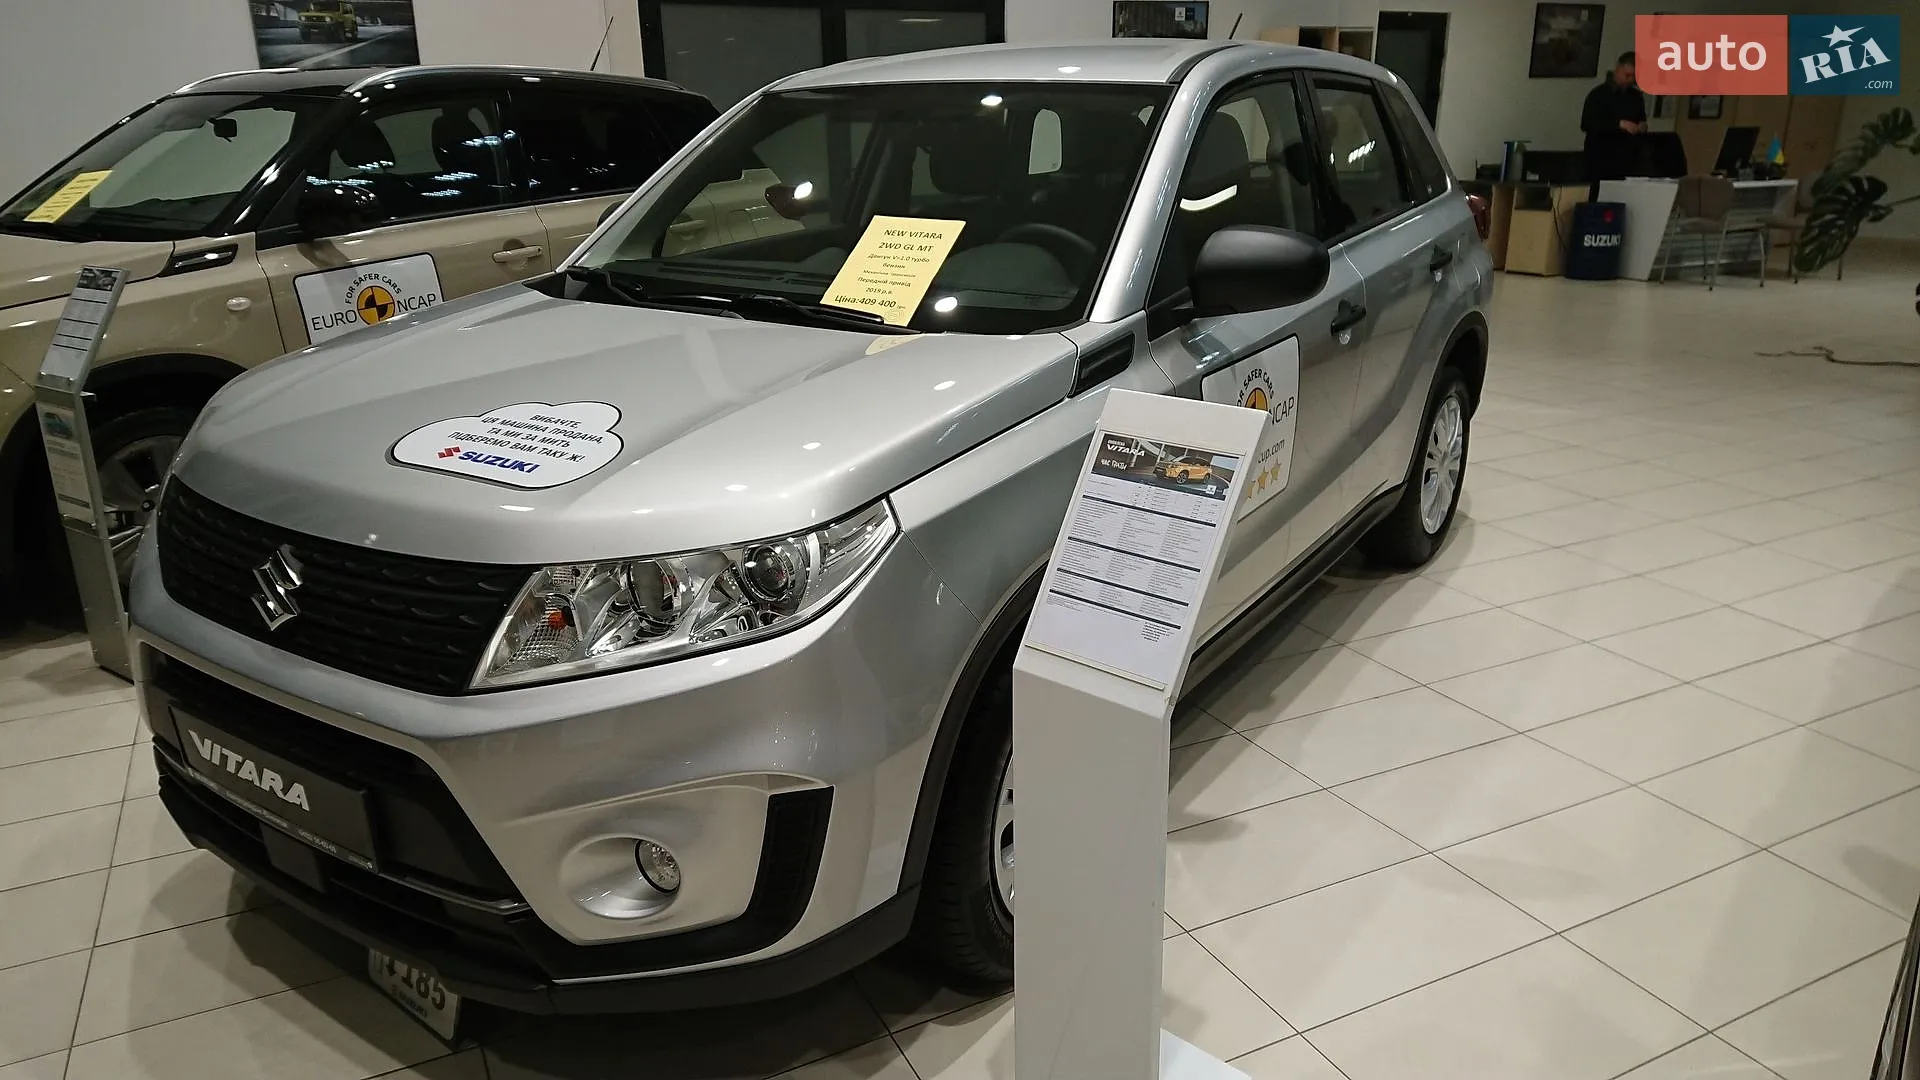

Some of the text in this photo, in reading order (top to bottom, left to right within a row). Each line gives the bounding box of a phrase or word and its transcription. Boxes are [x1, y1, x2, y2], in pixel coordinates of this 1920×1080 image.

[883, 229, 943, 240] NEW VITARA
[1583, 233, 1622, 248] SUZUKI
[878, 241, 902, 250] 2WD
[903, 243, 915, 251] GL
[345, 273, 402, 304] FOR SAFER CARS
[311, 293, 437, 331] EURO NCAP
[878, 300, 897, 308] 400
[1243, 368, 1263, 390] SAFER
[1263, 372, 1274, 399] CARS
[481, 416, 603, 445] ЦЯ МАШИНА ПРОДАНА,
[529, 415, 582, 429] ВИБАЧТЕ,
[447, 431, 511, 448] ПІДБЕРЕМО
[509, 442, 539, 453] ВАМ
[537, 447, 569, 459] ТАКУ
[486, 427, 570, 448] ТА МИ ЗА МИТЬ
[1107, 443, 1145, 457] VITARA
[458, 451, 541, 474] SUZUKI
[188, 729, 310, 812] VITARA
